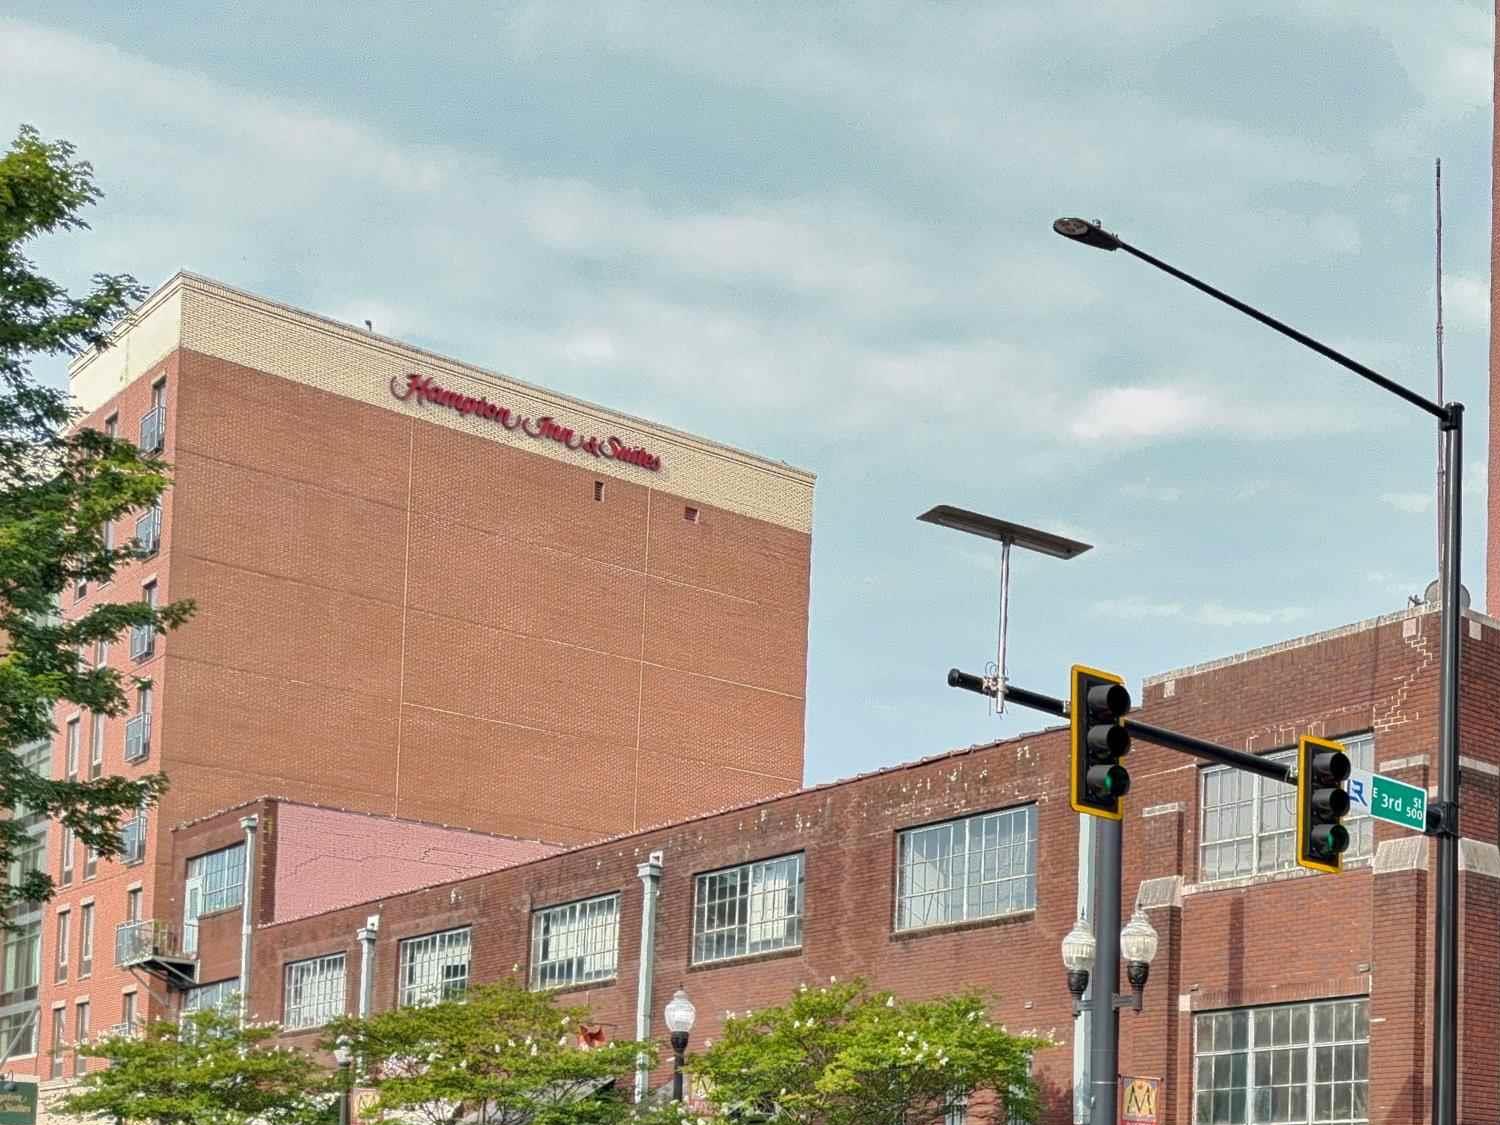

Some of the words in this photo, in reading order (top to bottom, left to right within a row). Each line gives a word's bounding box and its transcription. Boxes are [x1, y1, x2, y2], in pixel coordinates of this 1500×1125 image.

[390, 372, 522, 430] Hampton
[523, 415, 584, 451] Inn
[583, 436, 600, 458] &
[598, 435, 663, 473] Suites
[1372, 787, 1378, 799] E
[1381, 793, 1402, 812] 3rd
[1412, 797, 1422, 809] St
[1406, 806, 1423, 820] 500
